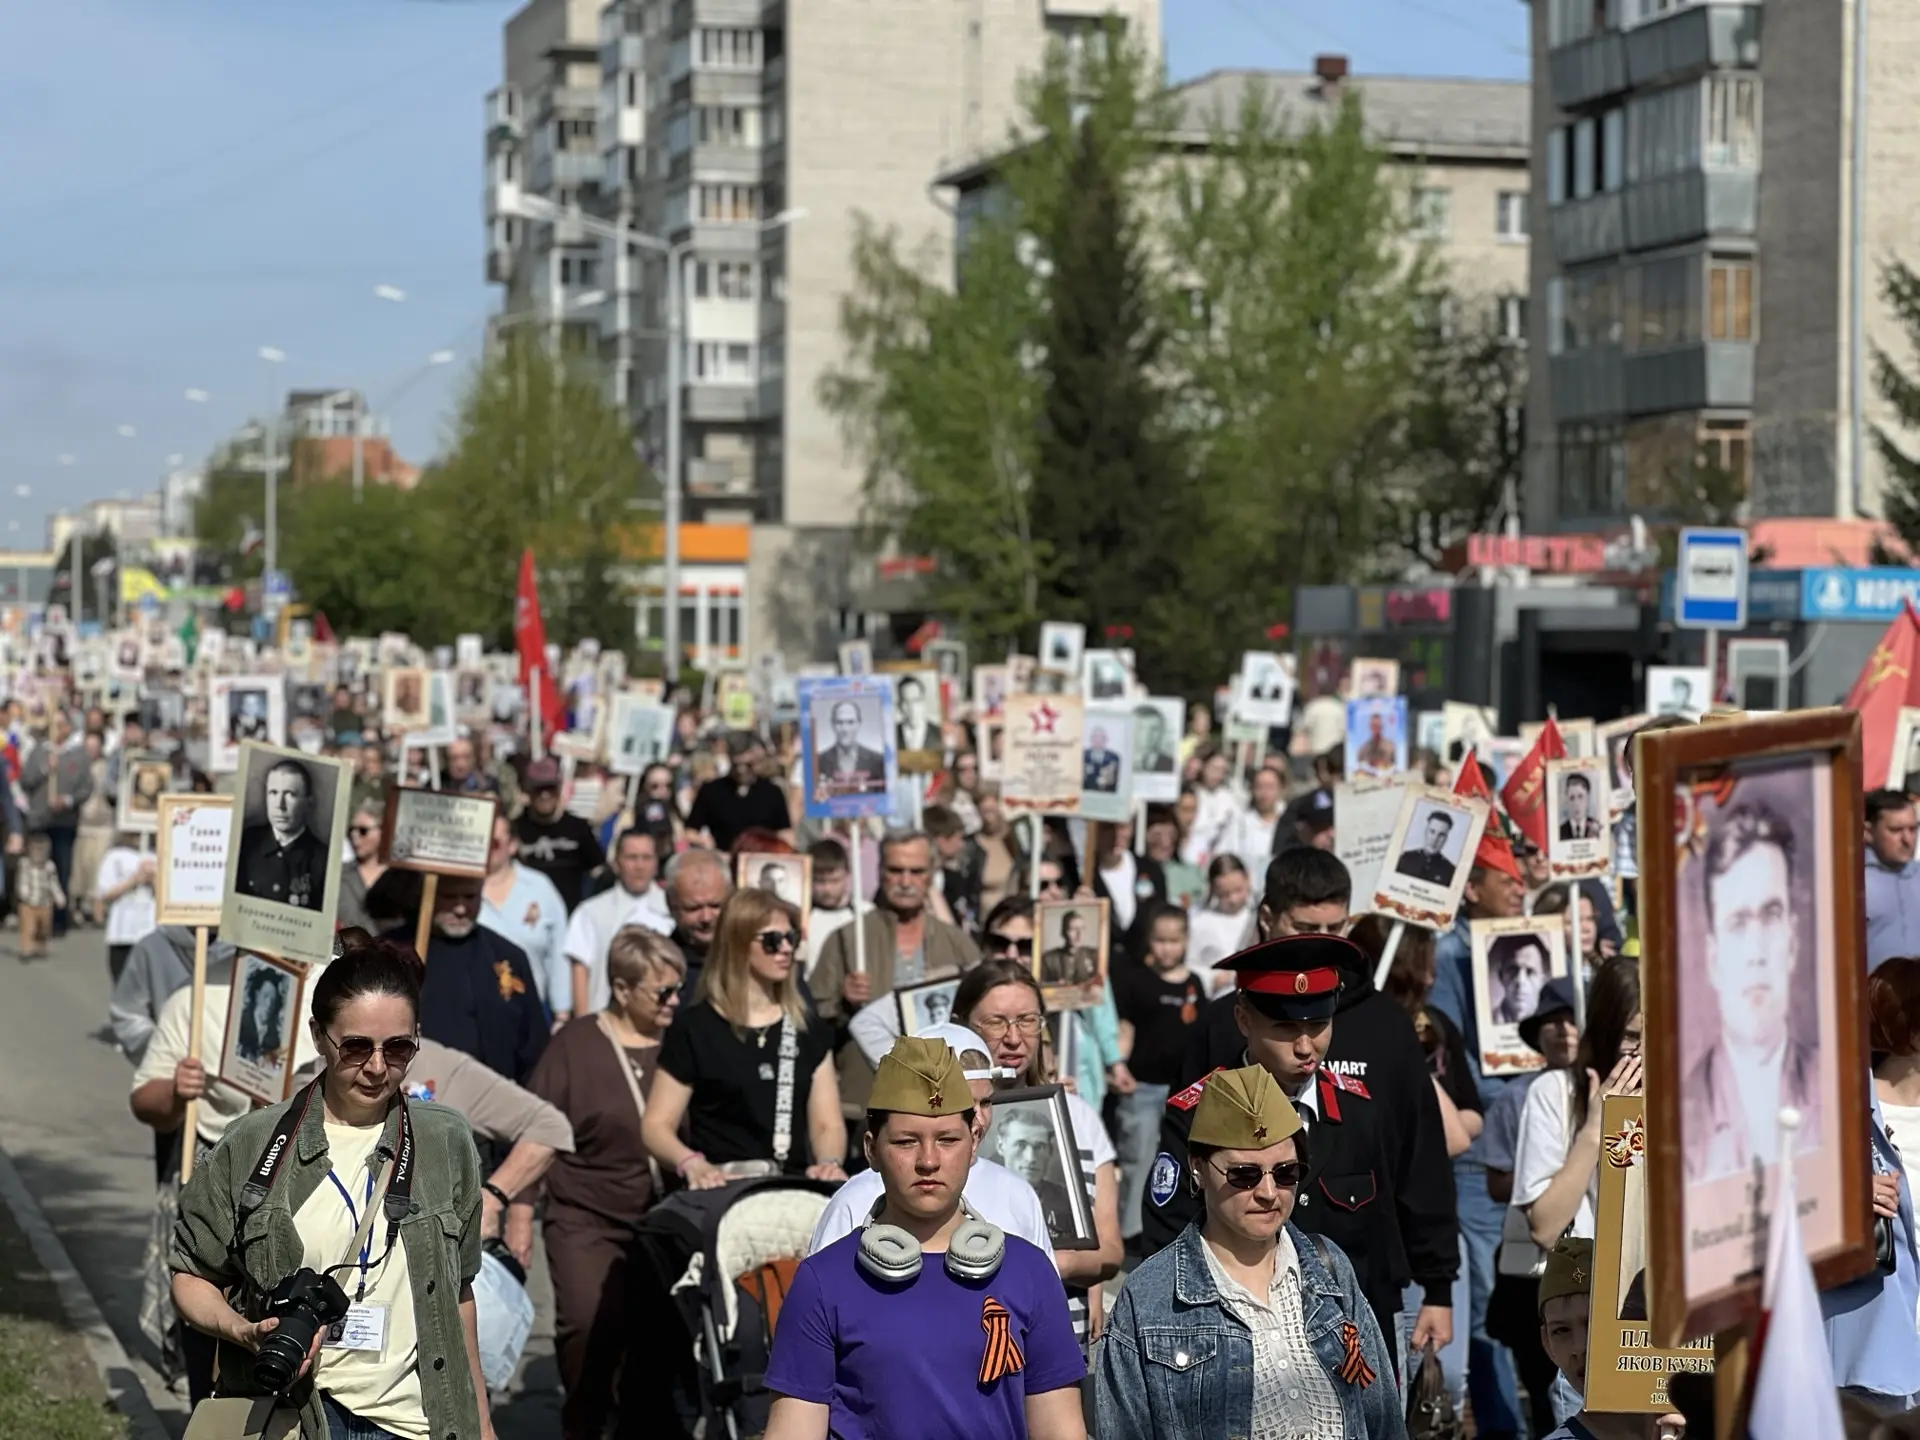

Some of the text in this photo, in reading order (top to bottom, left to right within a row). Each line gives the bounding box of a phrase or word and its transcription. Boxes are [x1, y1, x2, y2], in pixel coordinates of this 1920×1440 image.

[1468, 534, 1604, 570] ЦВЕТЫ
[259, 1134, 287, 1177] Canon
[396, 1137, 411, 1184] DIGITAL
[1616, 1356, 1664, 1372] ЯКОВ
